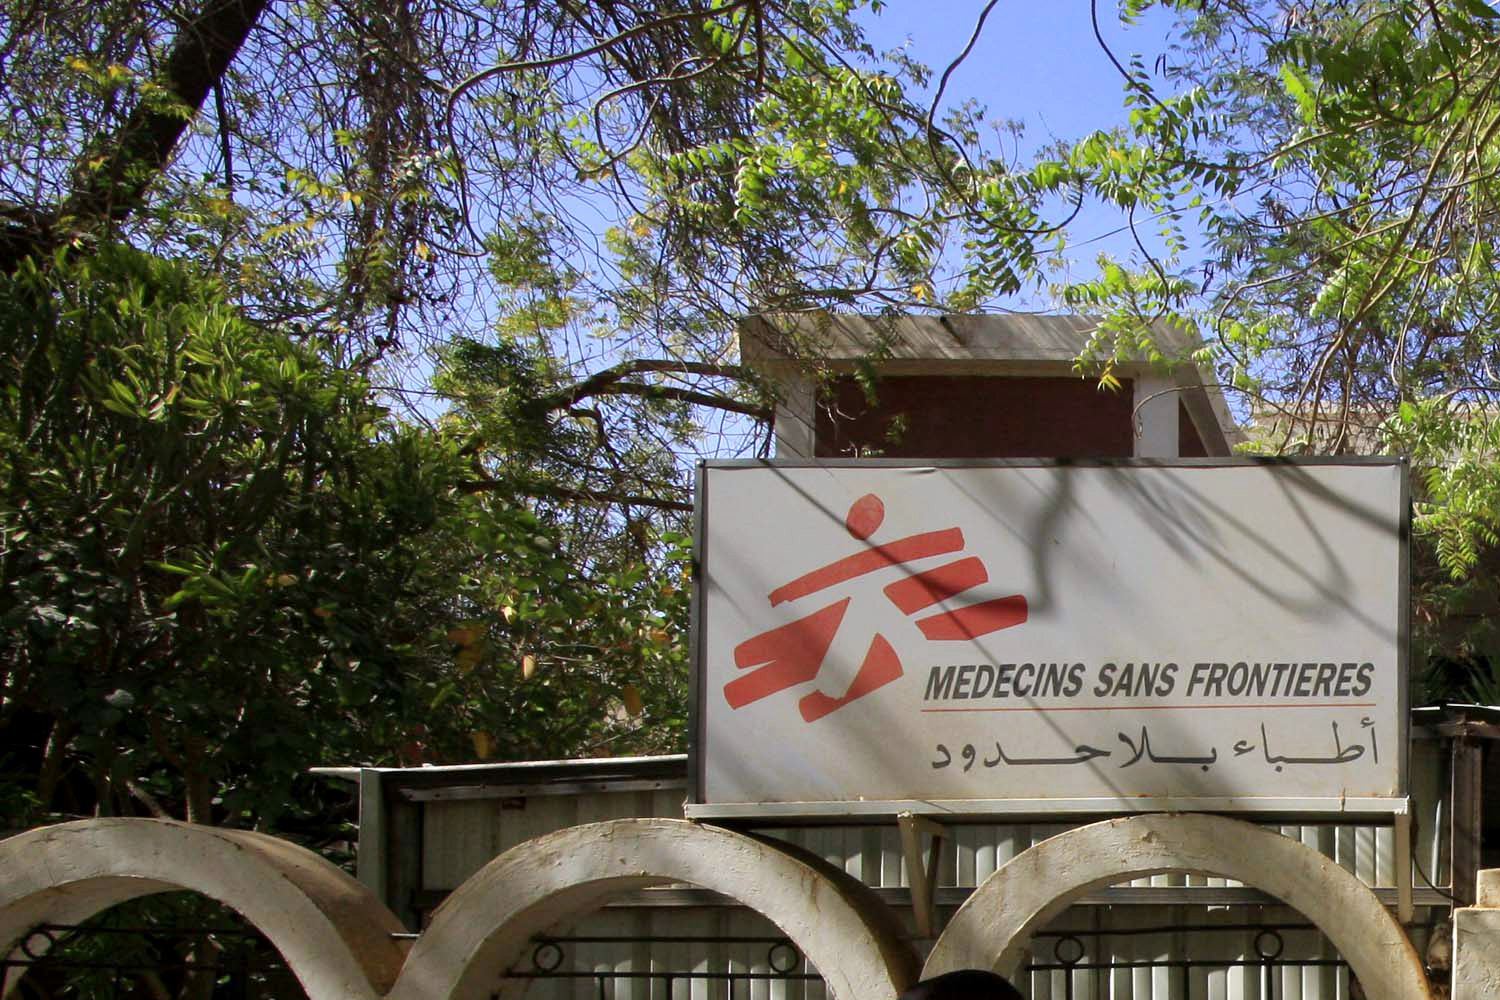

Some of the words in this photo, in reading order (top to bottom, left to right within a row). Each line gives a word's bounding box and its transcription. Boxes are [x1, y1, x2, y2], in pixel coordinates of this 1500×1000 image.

[924, 663, 1086, 701] MEDECINS
[1094, 662, 1178, 698] SANS
[1186, 662, 1376, 698] FRONTIERES
